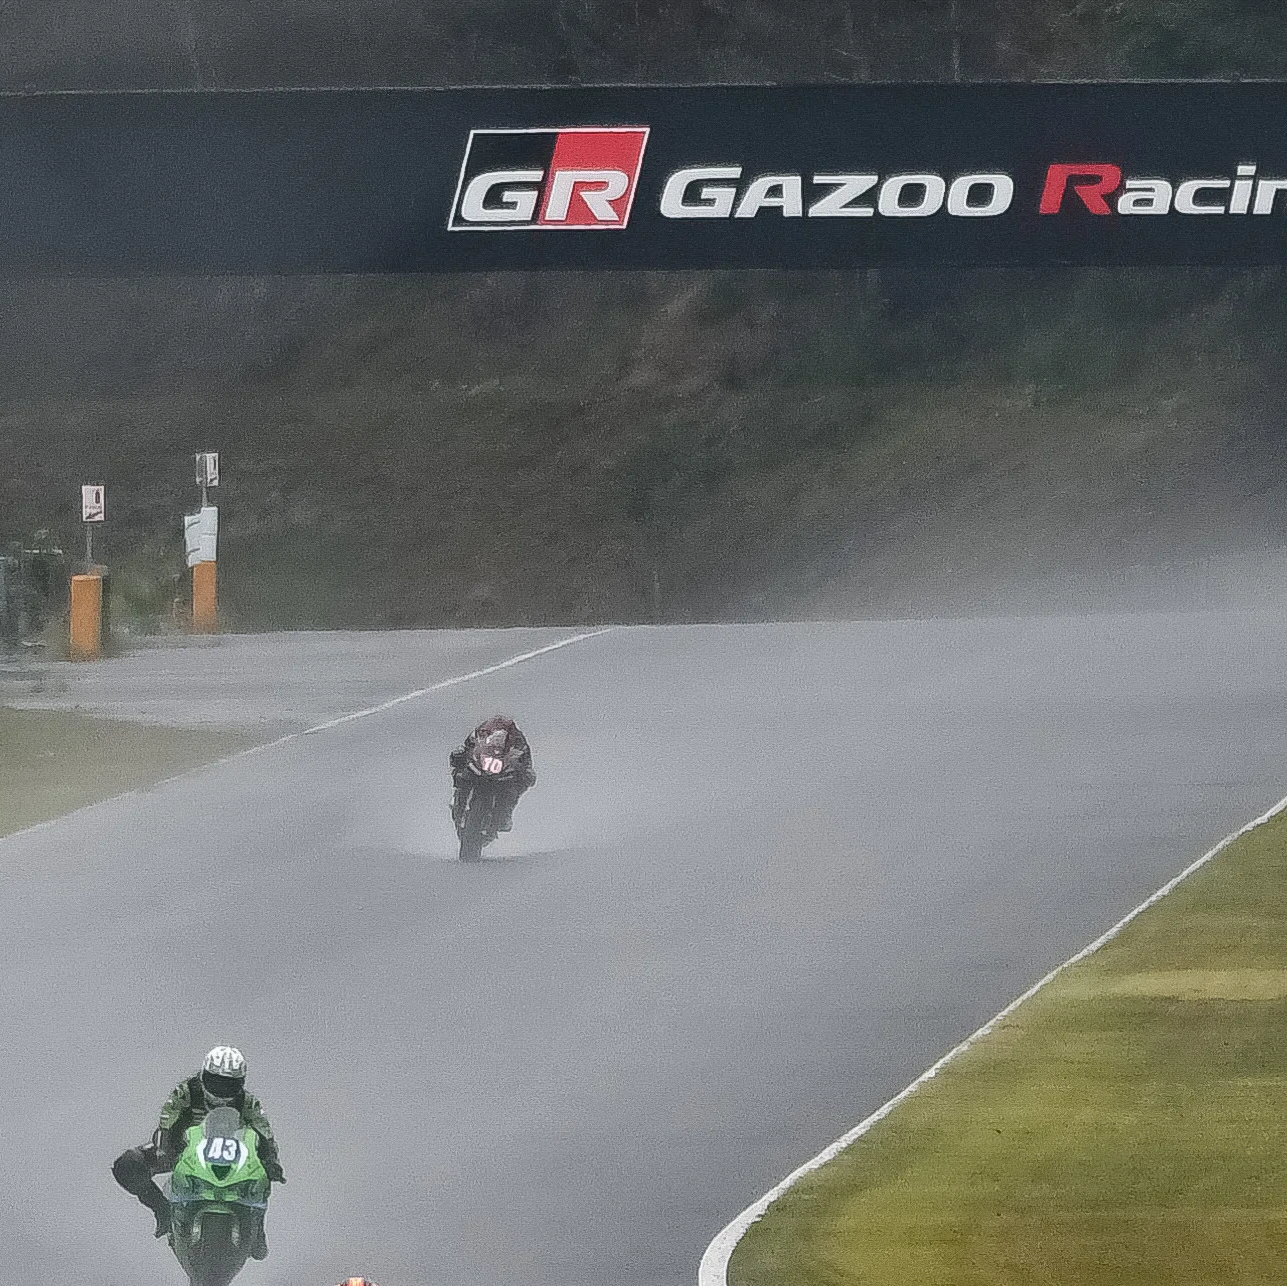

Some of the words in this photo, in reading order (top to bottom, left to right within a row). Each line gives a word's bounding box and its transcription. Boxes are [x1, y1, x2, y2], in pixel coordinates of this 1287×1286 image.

[462, 170, 629, 221] GR
[660, 167, 1014, 218] GAZOO
[208, 1138, 236, 1160] 43
